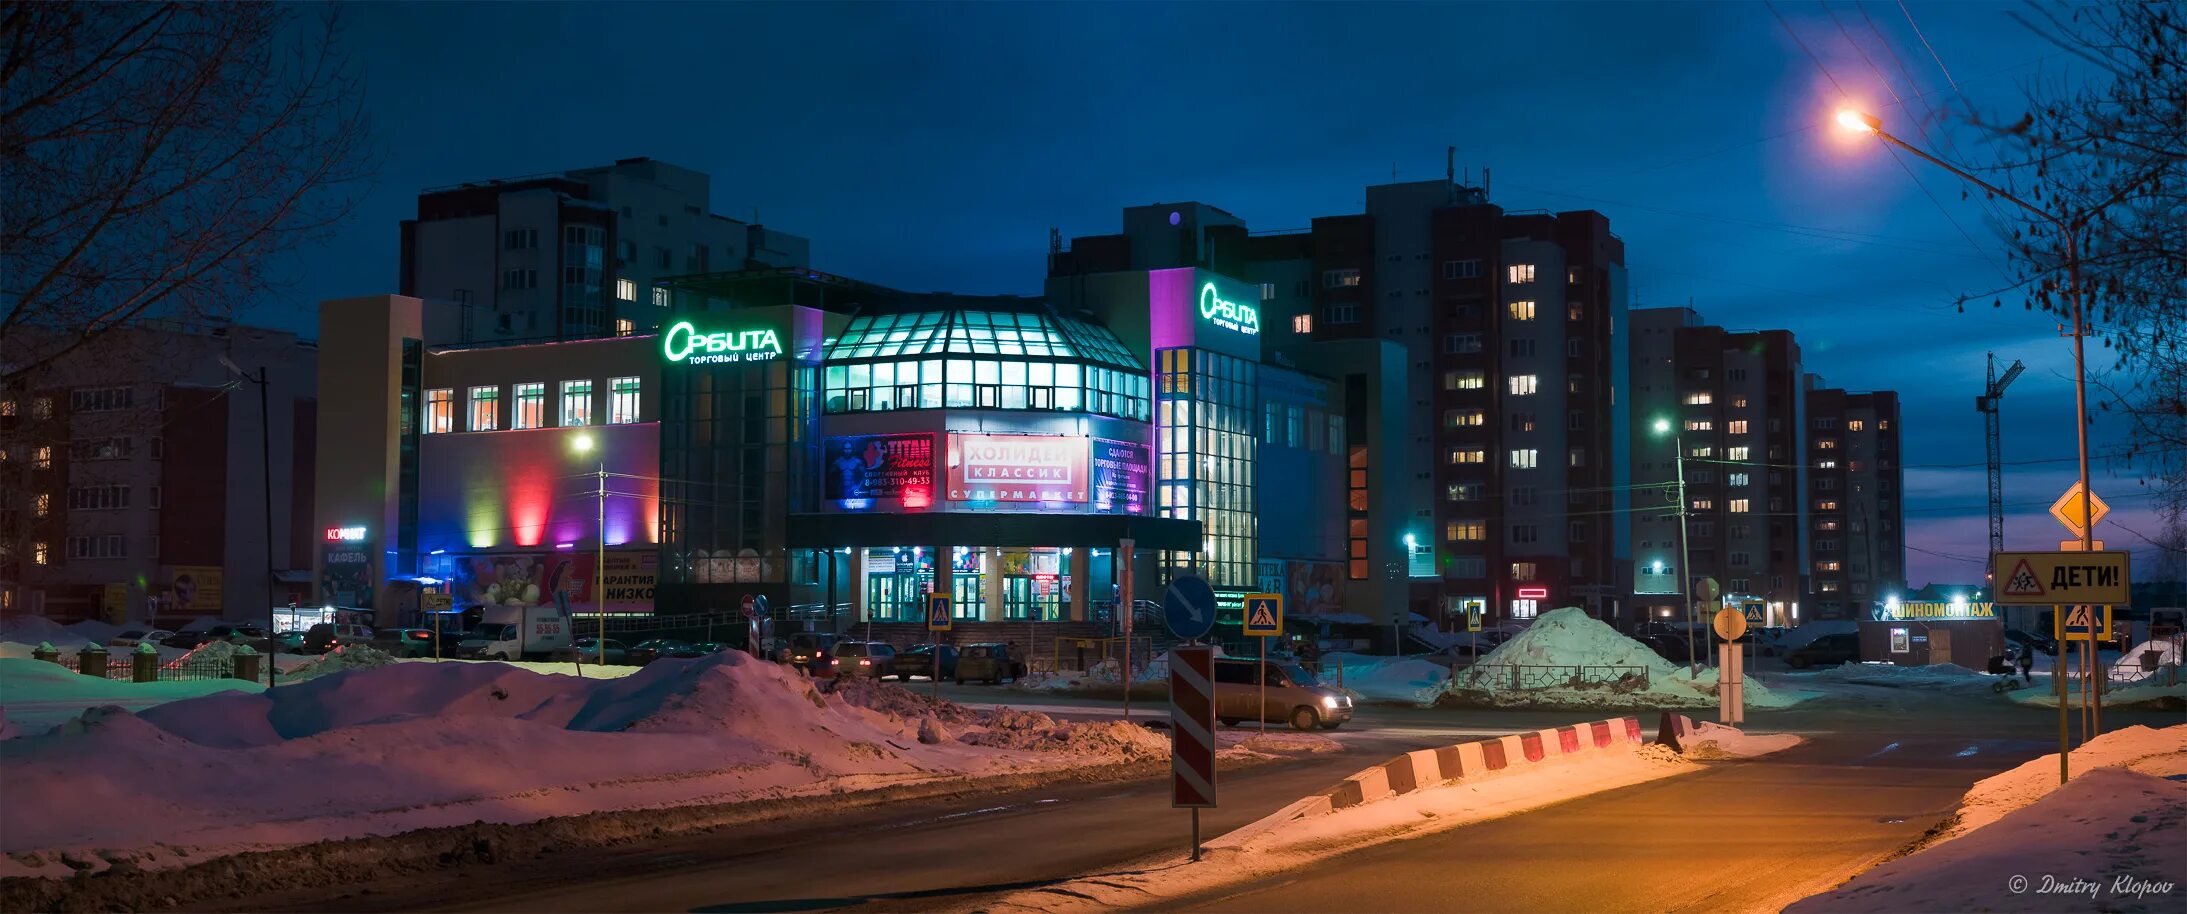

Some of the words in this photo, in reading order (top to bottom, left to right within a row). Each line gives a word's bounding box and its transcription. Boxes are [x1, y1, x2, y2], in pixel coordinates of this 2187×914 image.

[1213, 318, 1239, 331] ТОРГОВЫЙ
[689, 352, 739, 364] ТОРГОВЫЙ
[745, 351, 776, 361] ЦЕНТР
[888, 440, 930, 460] TITAN
[969, 446, 1068, 463] ХОЛИДЕЙ
[974, 467, 1062, 479] КЛАССИК
[950, 490, 1085, 500] СУПЕРМАРКЕТ
[328, 552, 367, 563] КАФЕЛЬ
[1258, 563, 1284, 576] ПТЕКА
[2050, 565, 2120, 591] ДЕТИ!
[606, 587, 655, 600] НИЗКО
